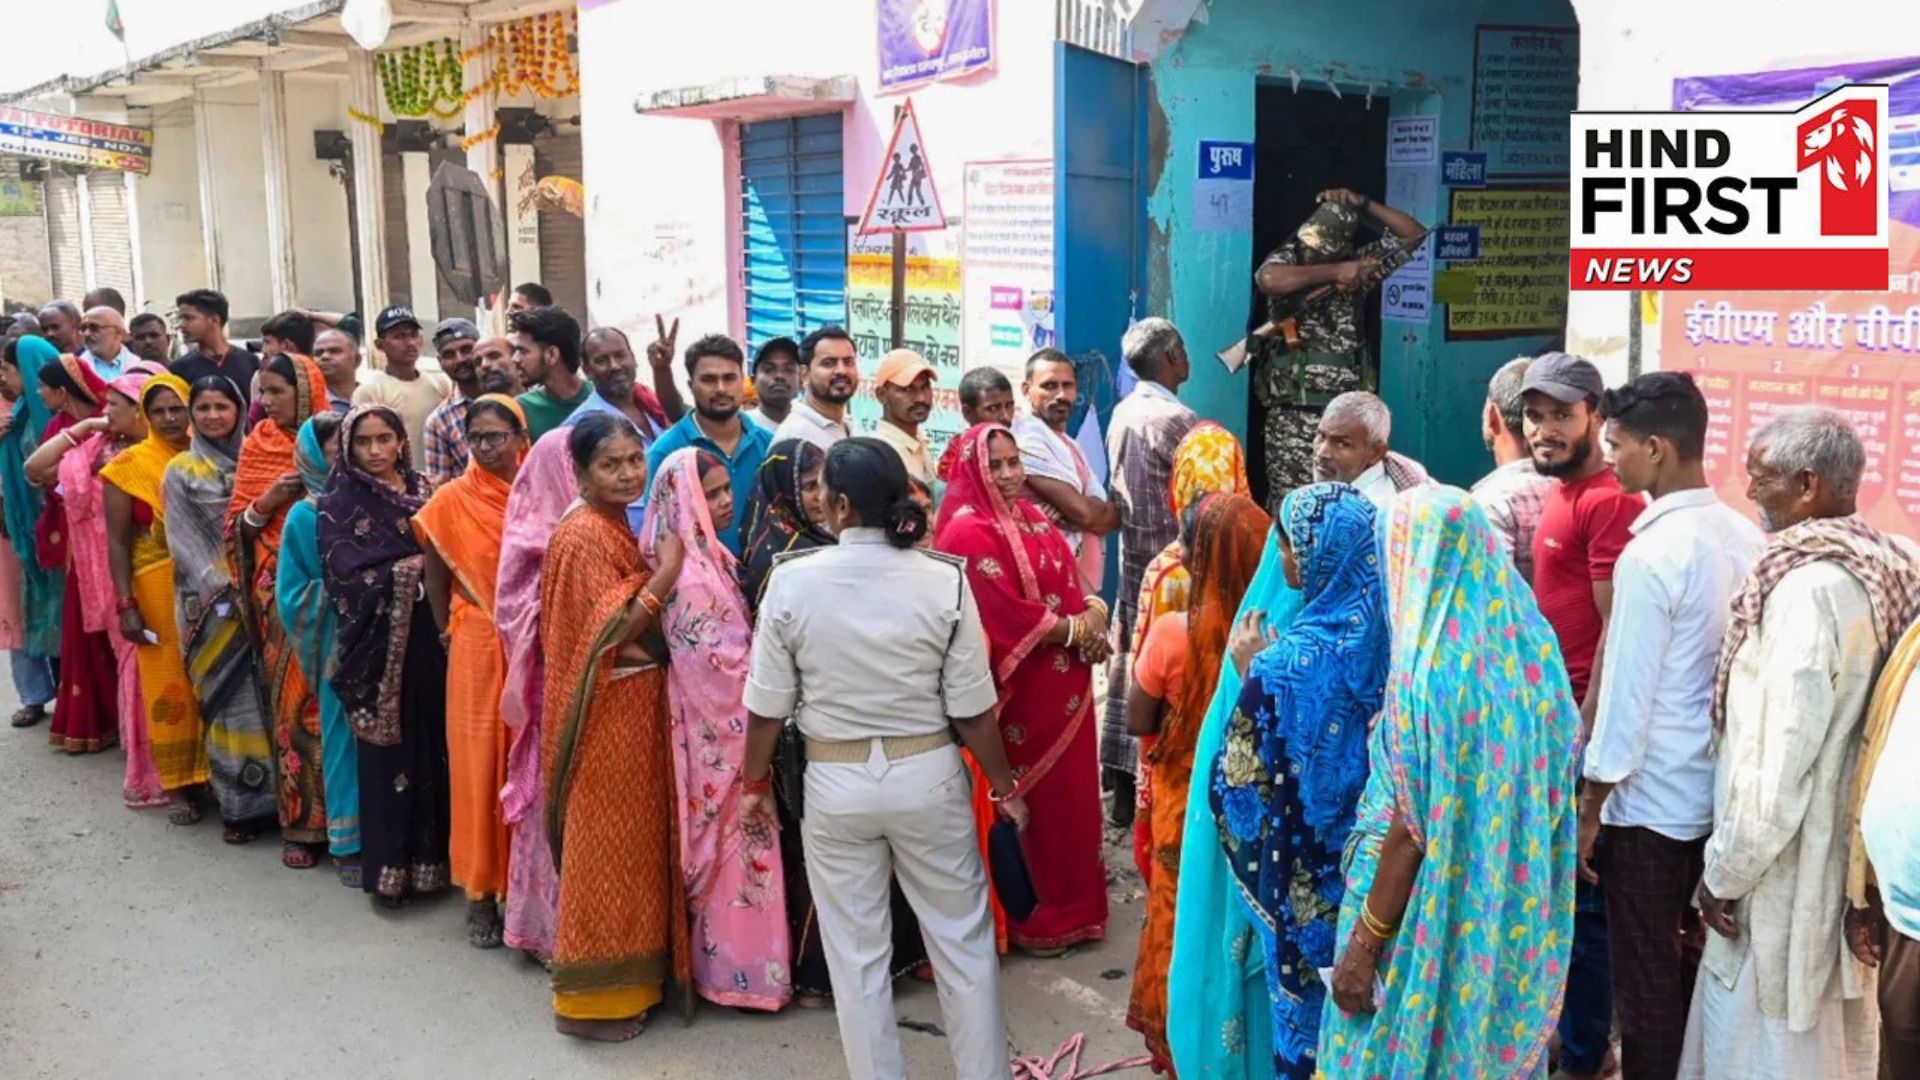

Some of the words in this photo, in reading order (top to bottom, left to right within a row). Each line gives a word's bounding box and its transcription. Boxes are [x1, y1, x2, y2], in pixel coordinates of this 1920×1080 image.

[32, 113, 145, 143] TUTORIAL
[104, 142, 143, 154] NDA
[1209, 146, 1243, 174] पुरुष
[1446, 157, 1482, 180] महिला
[877, 206, 931, 224] स्कूल
[1684, 300, 1778, 347] ईवीएम
[1787, 301, 1849, 349] और
[1773, 360, 1783, 374] 2
[1850, 364, 1861, 379] 3
